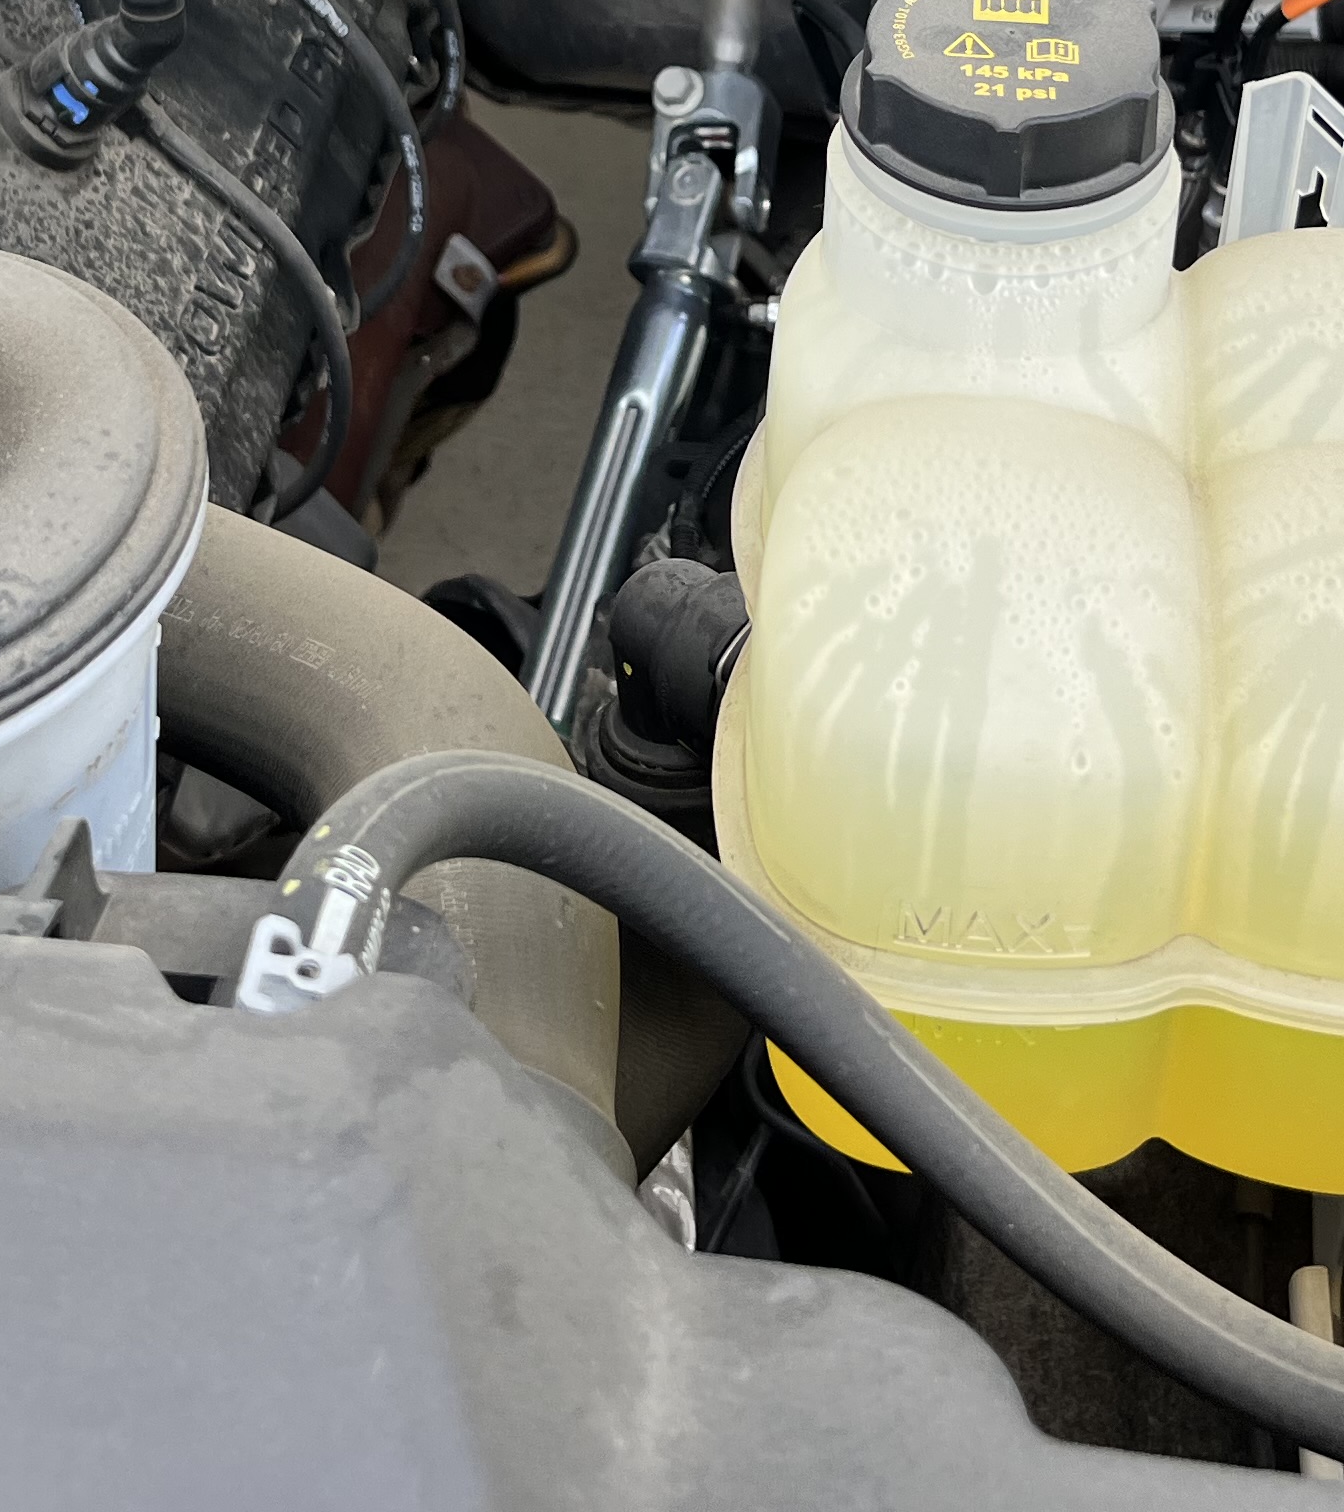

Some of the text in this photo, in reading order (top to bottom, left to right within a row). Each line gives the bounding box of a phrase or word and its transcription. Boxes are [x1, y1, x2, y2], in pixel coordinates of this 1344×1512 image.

[960, 64, 1070, 82] 145 kPa
[973, 83, 1057, 101] 21 psi
[325, 844, 381, 903] RAD
[898, 901, 1057, 952] MAX
